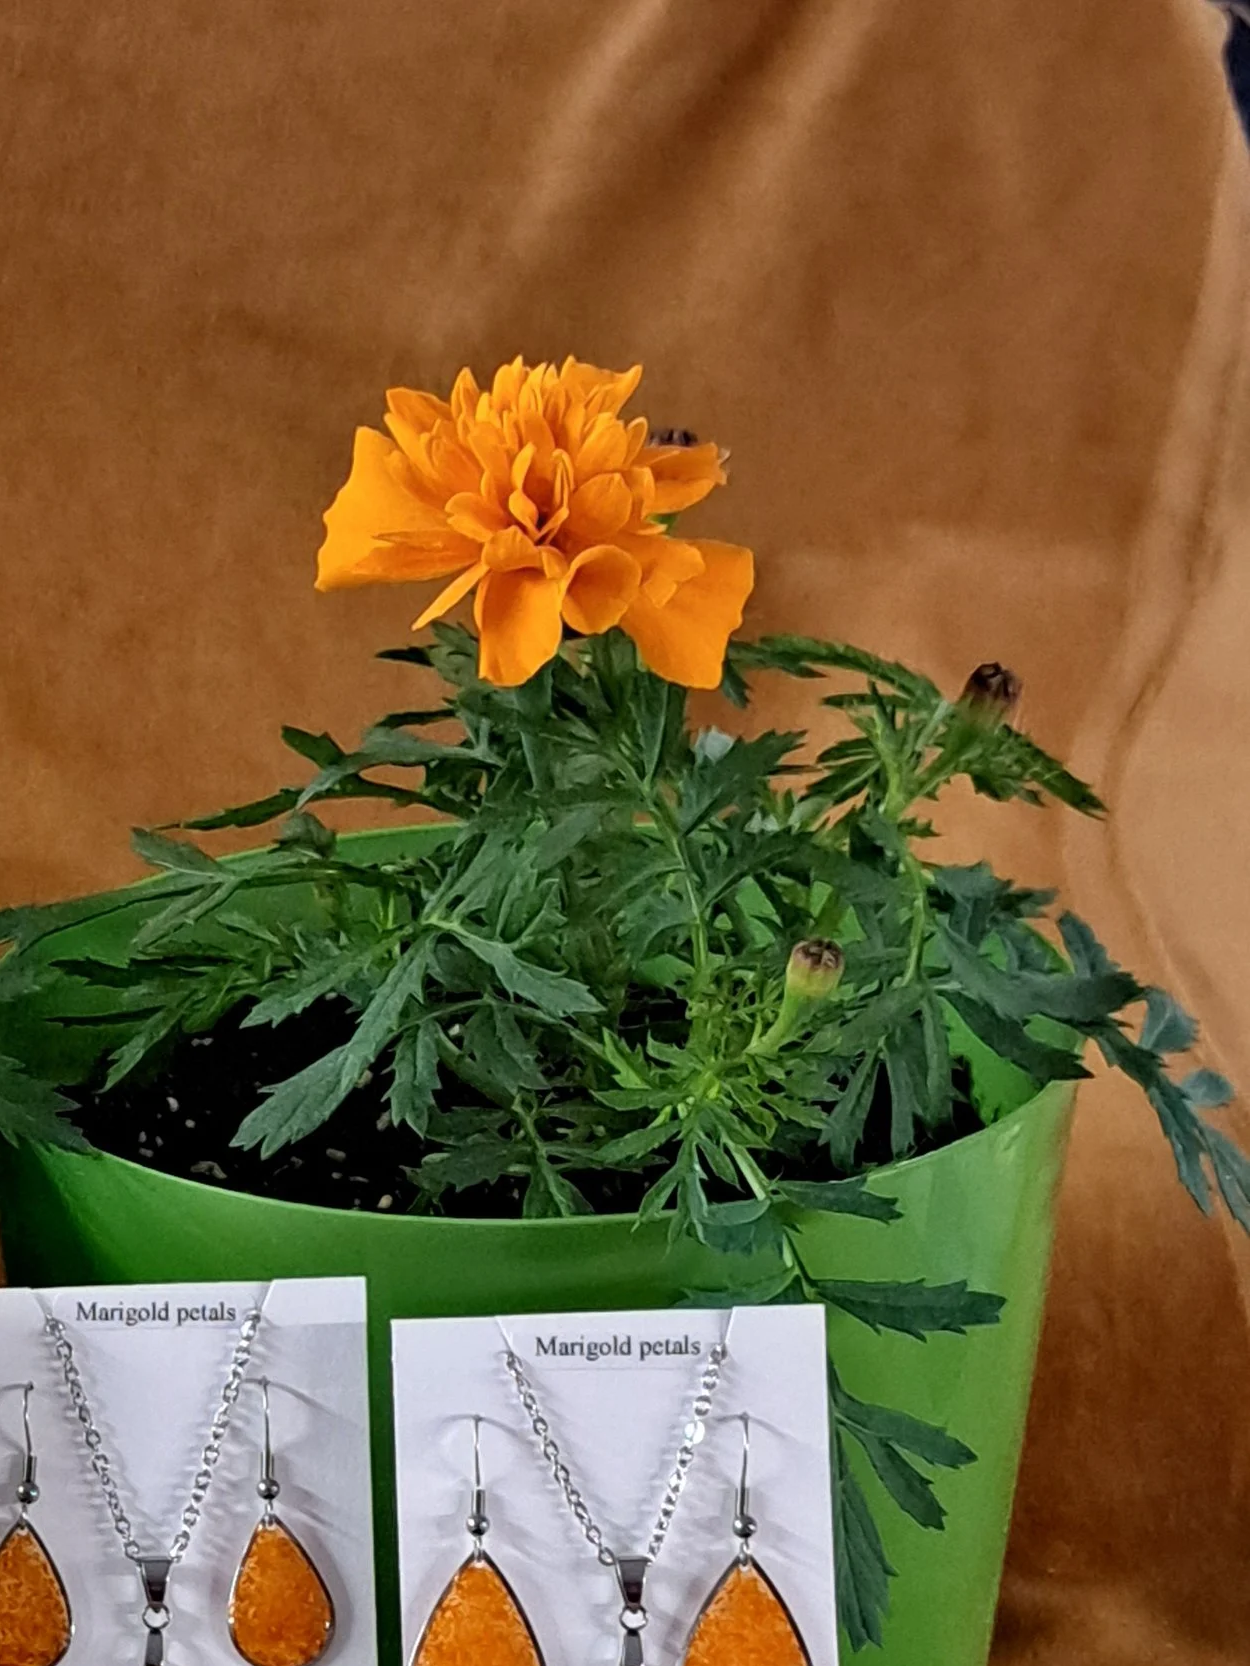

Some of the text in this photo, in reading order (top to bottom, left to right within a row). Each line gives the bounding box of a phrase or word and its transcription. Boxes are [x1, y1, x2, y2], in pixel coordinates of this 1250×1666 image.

[76, 1302, 236, 1326] Marigold petals
[536, 1335, 700, 1361] Marigold petals
